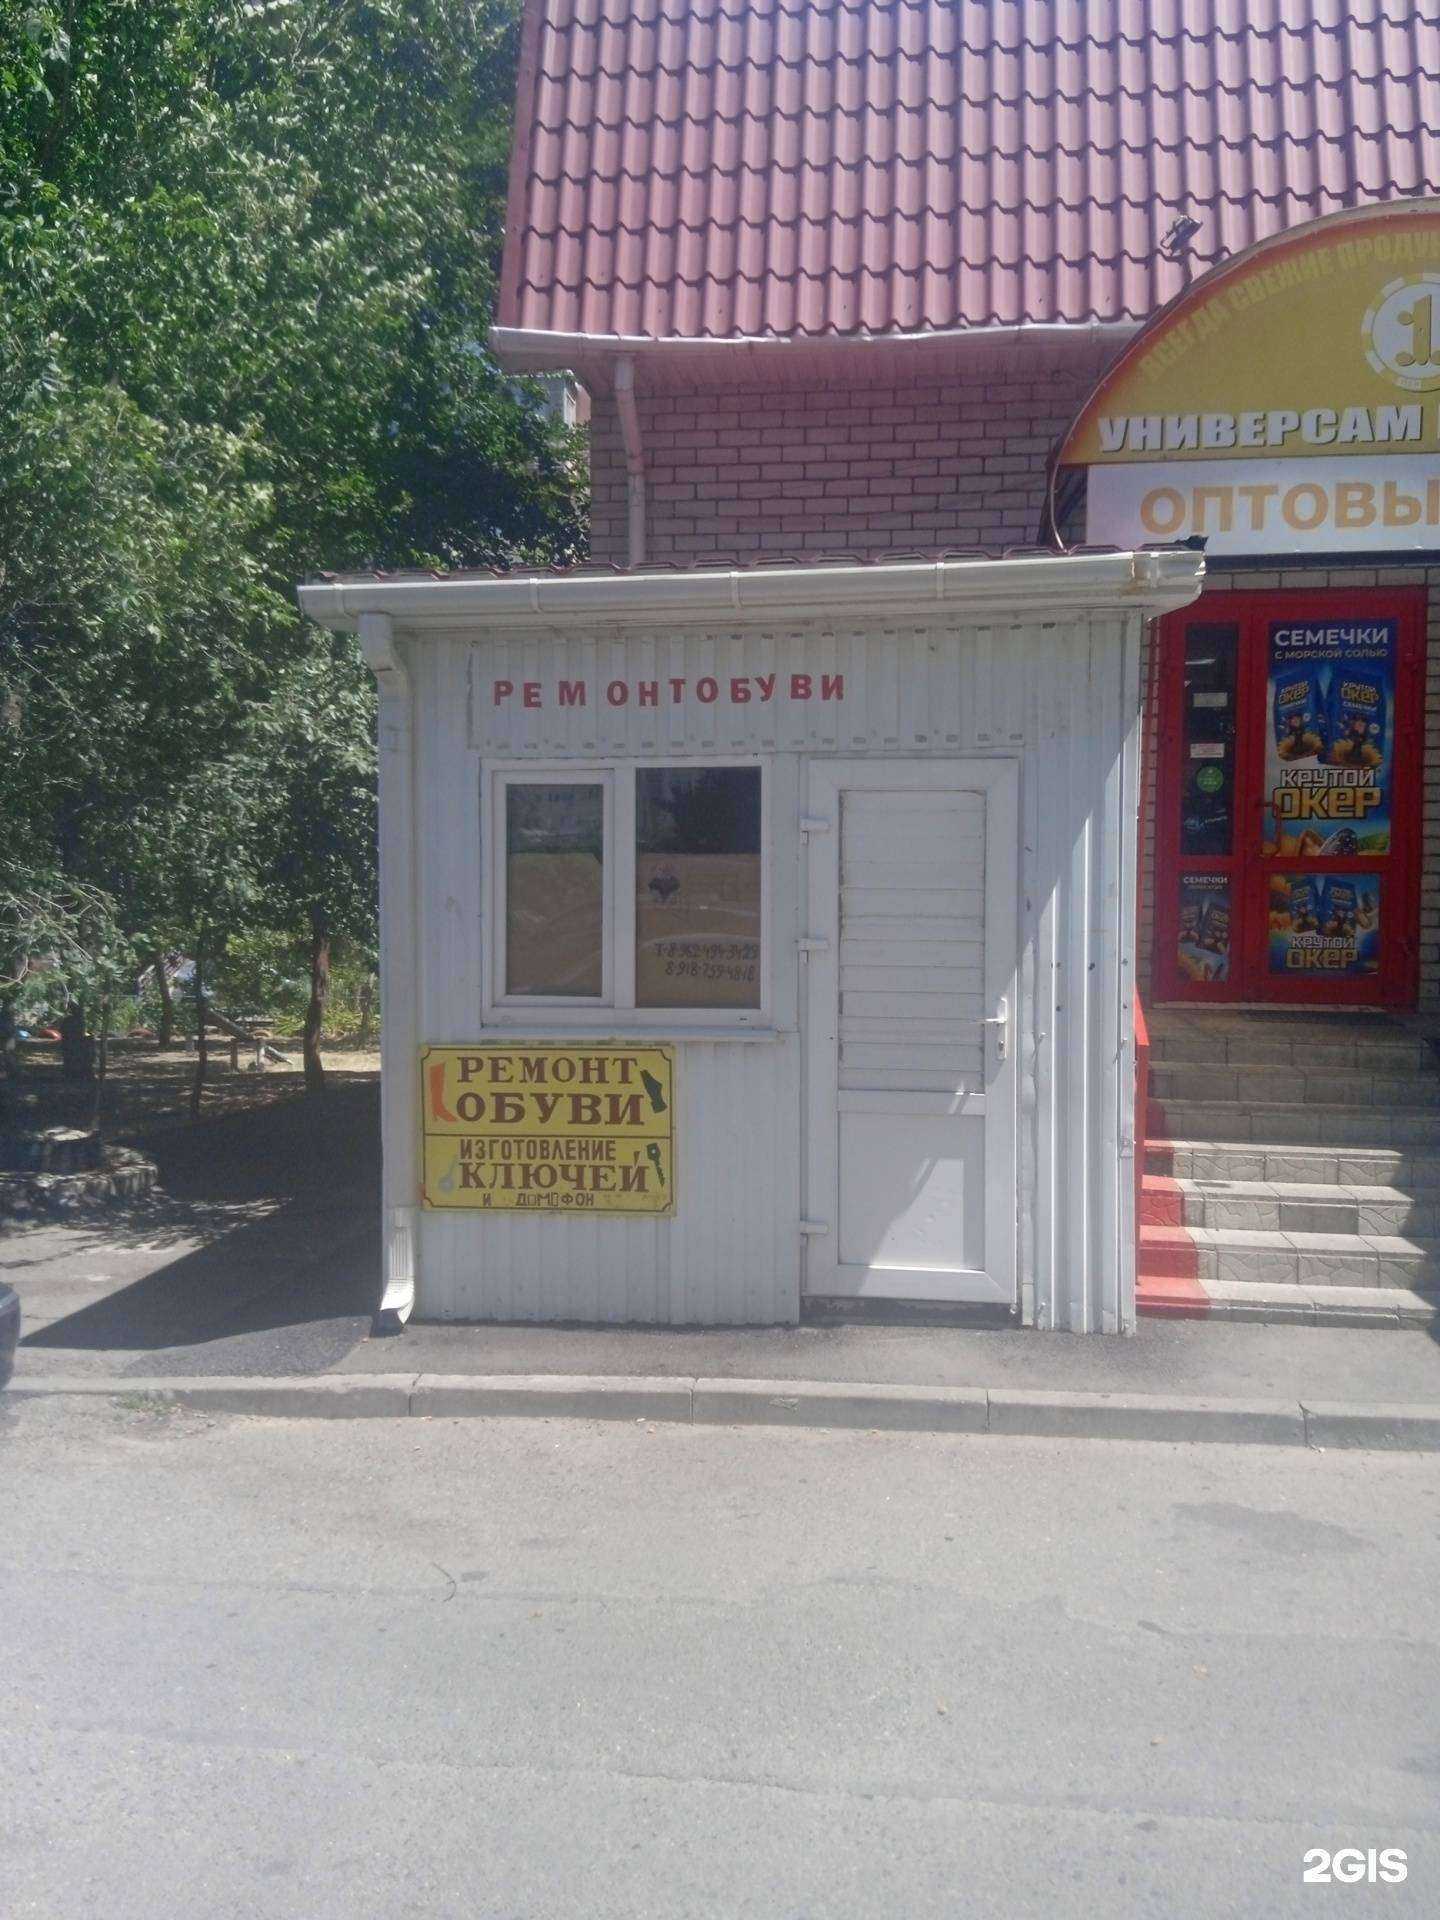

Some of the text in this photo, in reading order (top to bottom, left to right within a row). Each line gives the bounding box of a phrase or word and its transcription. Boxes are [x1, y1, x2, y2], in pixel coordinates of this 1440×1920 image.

[1098, 405, 1424, 453] УНИВЕРСАМ
[1140, 479, 1440, 536] ОПТОВЫ
[1275, 627, 1389, 647] СЕМЕЧКИ
[1274, 649, 1388, 660] С МОРСКОЙ СОЛЬЮ
[1280, 767, 1375, 787] КРУТОЙ
[1291, 935, 1355, 948] КРУТОЙ
[457, 1056, 638, 1084] РЕМОНТ
[456, 1092, 645, 1125] ОБУВИ
[460, 1138, 616, 1161] ИЗГОТОВЛЕНИЕ
[459, 1150, 650, 1192] КЛЮЧЕЙ
[483, 1193, 491, 1206] И
